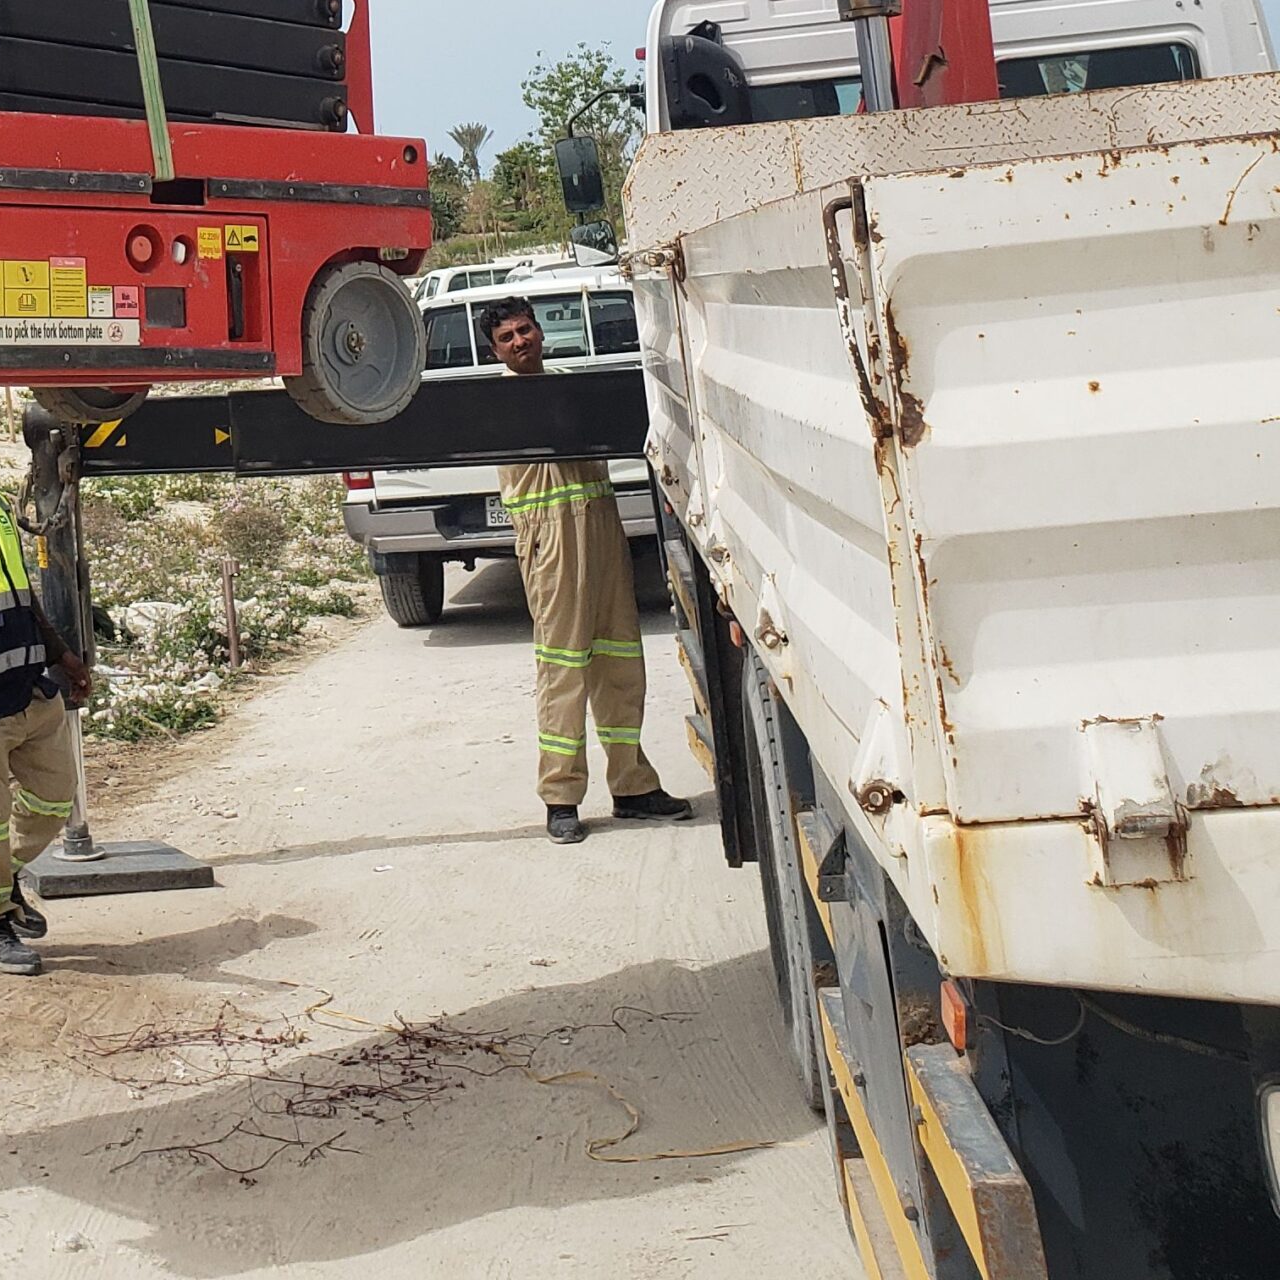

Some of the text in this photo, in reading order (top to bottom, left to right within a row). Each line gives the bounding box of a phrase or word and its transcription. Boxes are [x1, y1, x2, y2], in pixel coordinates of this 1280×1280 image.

[5, 324, 13, 339] to
[14, 321, 28, 342] pick
[30, 322, 42, 339] the
[43, 322, 57, 339] fork
[59, 322, 84, 339] bottom
[85, 323, 103, 342] plate
[490, 511, 511, 524] 562
